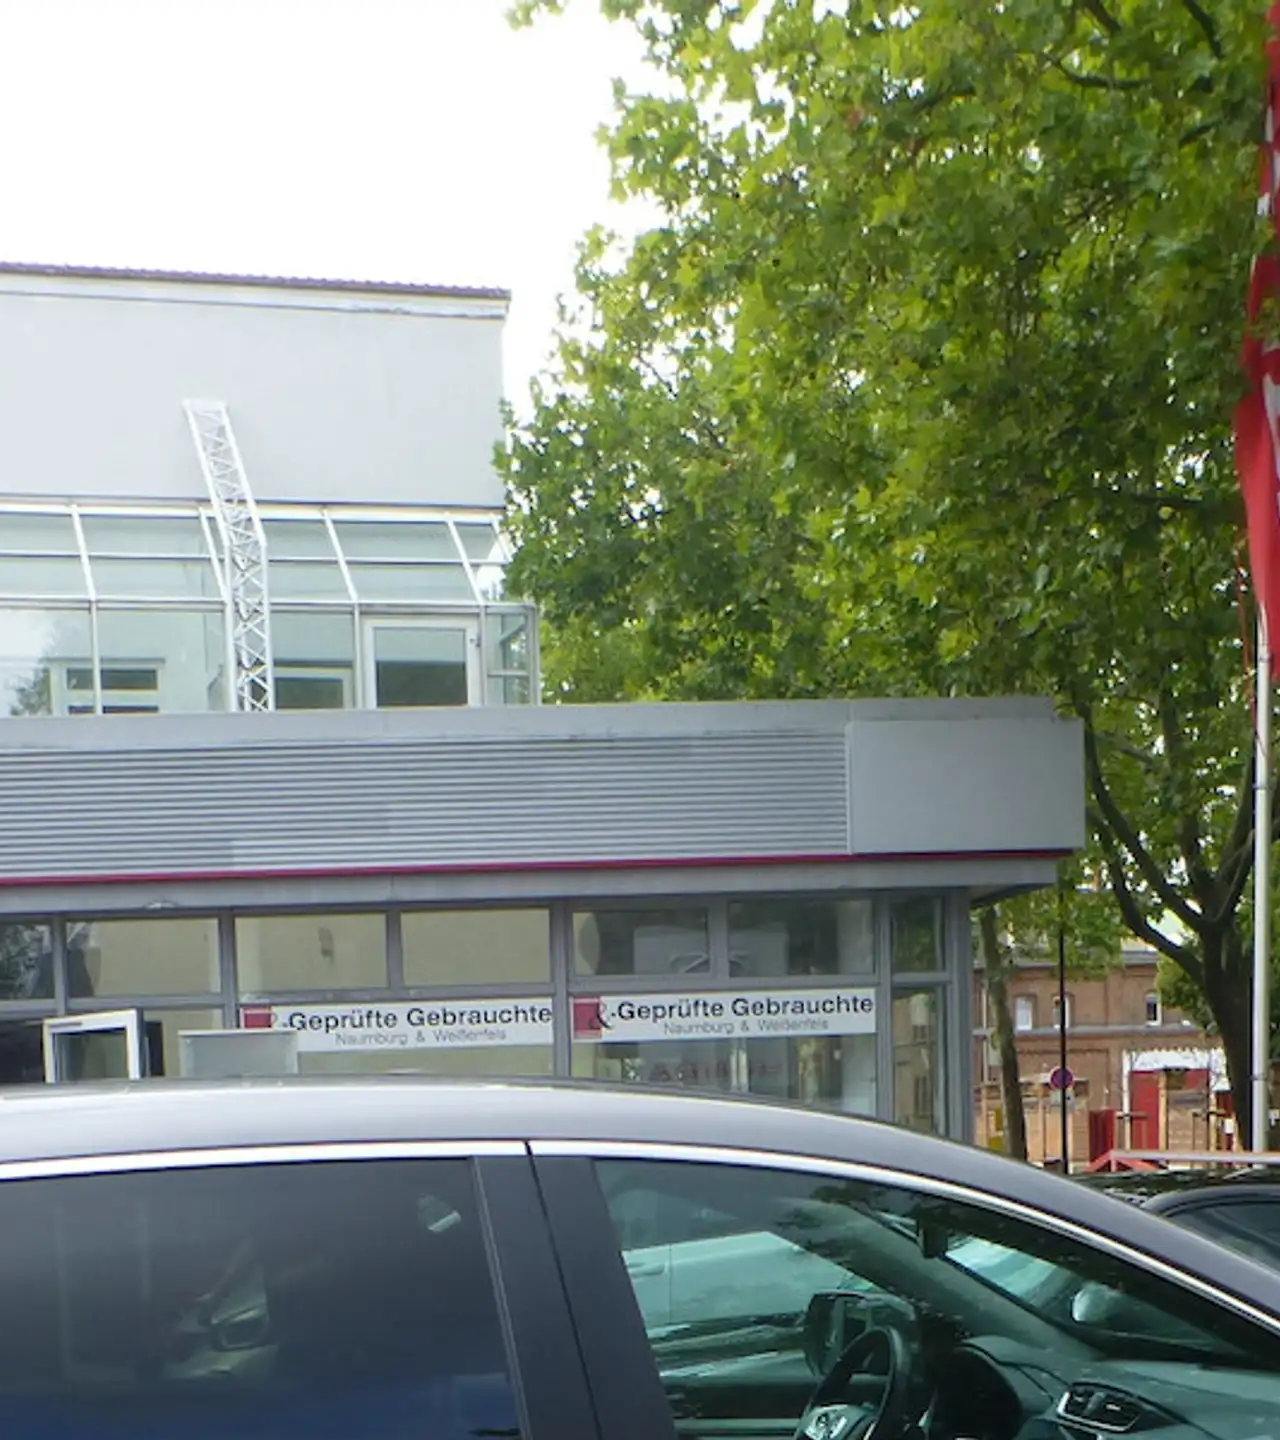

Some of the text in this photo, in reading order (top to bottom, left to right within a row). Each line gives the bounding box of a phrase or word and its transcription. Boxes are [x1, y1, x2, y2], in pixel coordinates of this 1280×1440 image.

[731, 995, 874, 1017] Gebrauchte
[406, 1005, 553, 1028] Gebrauchte
[334, 1029, 409, 1047] Naumburg
[416, 1028, 427, 1043] &
[664, 1020, 734, 1036] Naumburg
[741, 1019, 751, 1033] &
